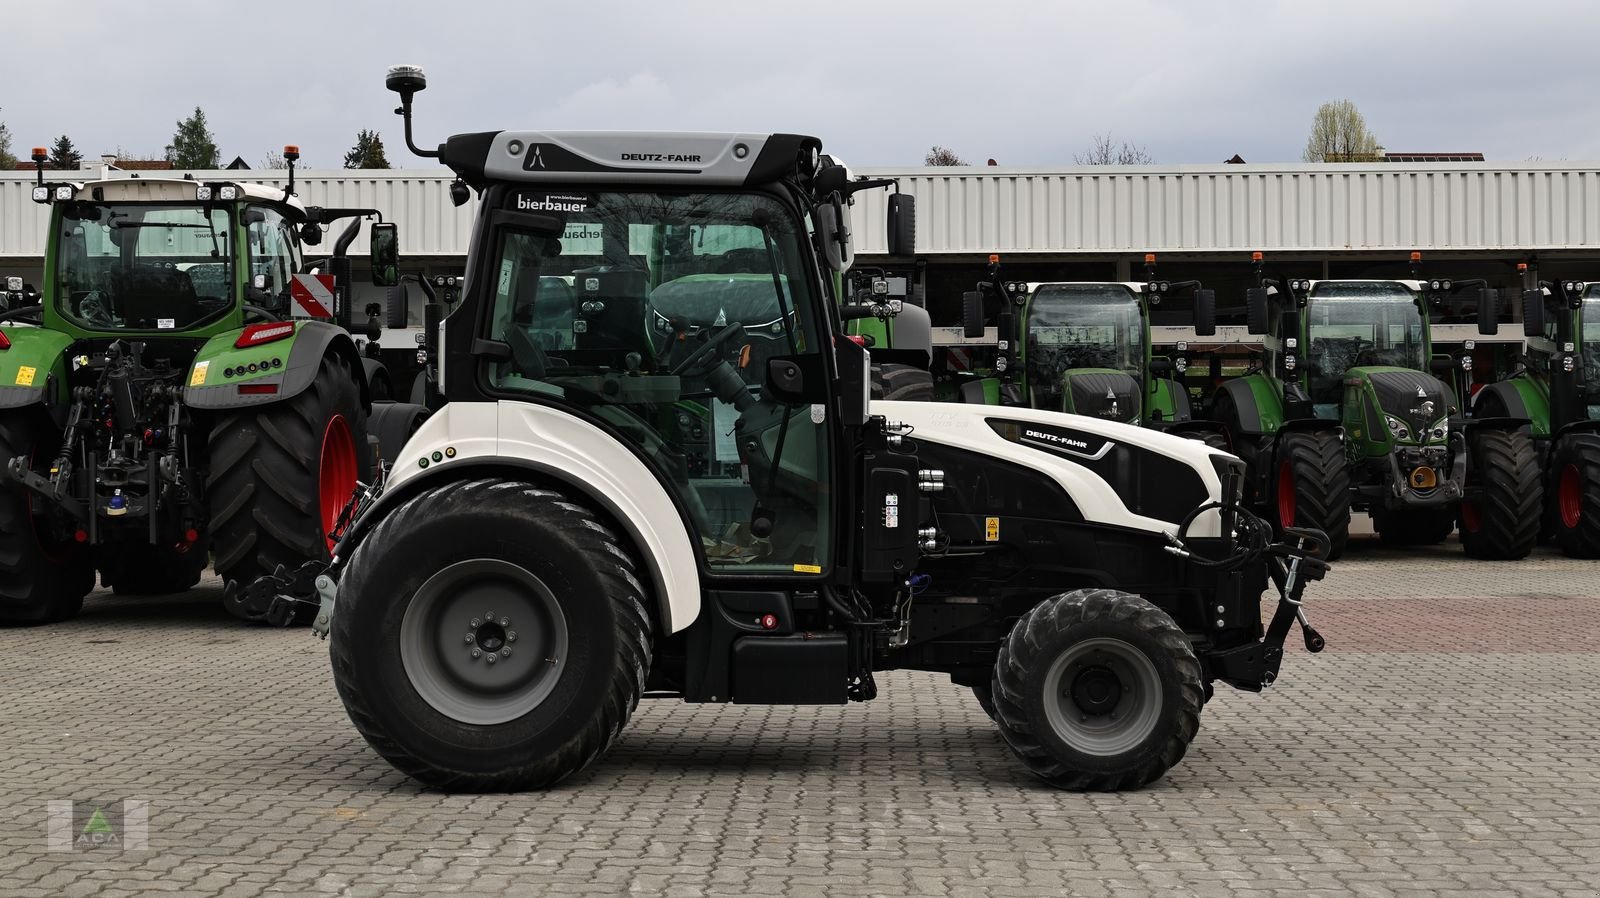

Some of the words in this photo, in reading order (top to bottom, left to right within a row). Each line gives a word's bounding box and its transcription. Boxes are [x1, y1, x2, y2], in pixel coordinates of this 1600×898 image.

[621, 153, 701, 162] DEUTZ-FAHR
[517, 194, 587, 212] bierbauer
[1026, 430, 1087, 449] DEUTZ-FAHR
